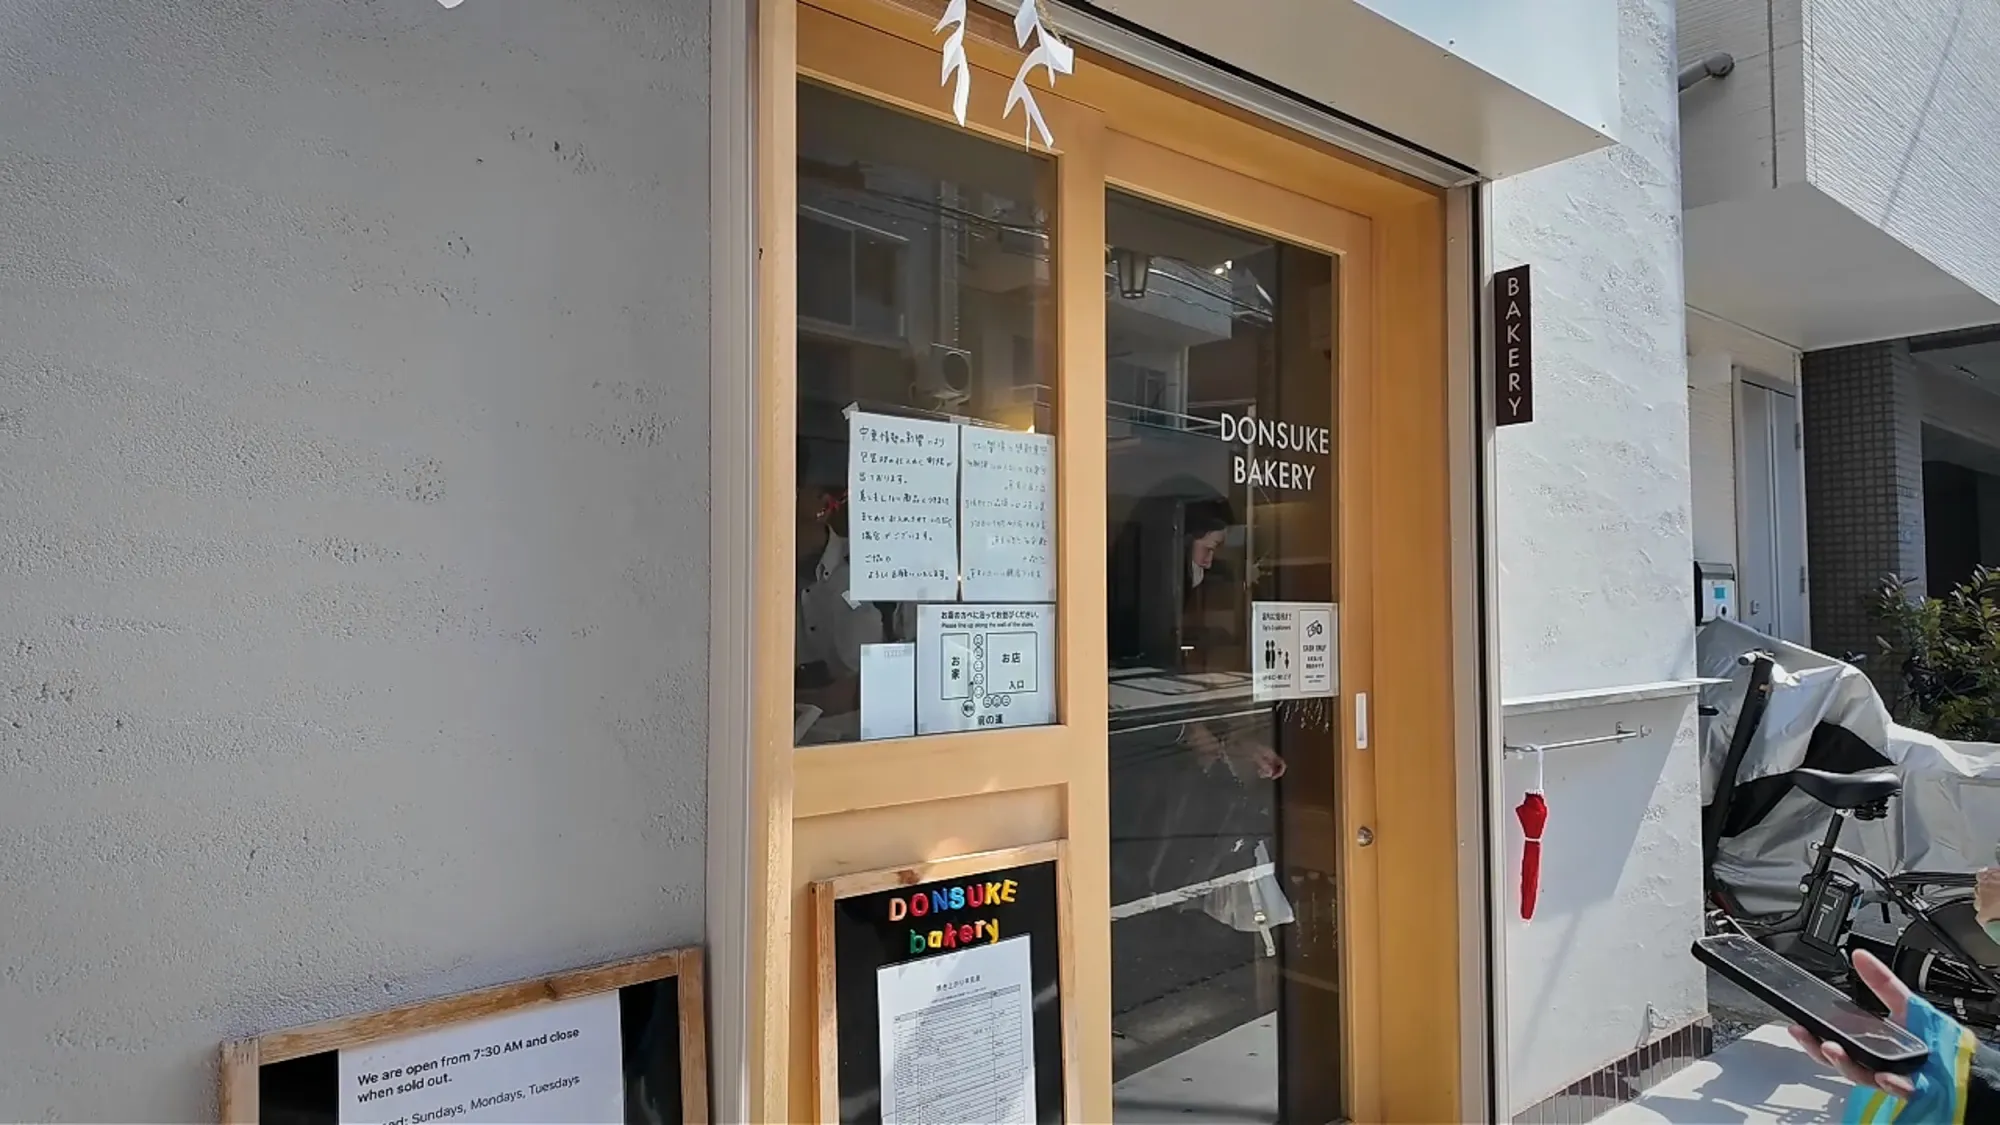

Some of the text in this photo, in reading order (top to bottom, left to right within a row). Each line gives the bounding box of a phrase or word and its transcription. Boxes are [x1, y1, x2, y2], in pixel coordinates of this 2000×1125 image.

[1505, 277, 1522, 417] BAKERY
[1220, 412, 1330, 455] DONSUKE
[1234, 455, 1316, 490] BAKERY
[1002, 652, 1021, 663] お店
[1009, 680, 1024, 690] 入口
[888, 879, 1018, 921] DONSUKE
[910, 918, 1000, 954] bakery
[357, 1027, 580, 1086] We are open from 7:30 AM and close
[357, 1073, 453, 1103] when sold out.
[411, 1102, 467, 1125] Sundays,
[470, 1088, 526, 1110] Mondays,
[528, 1075, 581, 1095] Tuesdays
